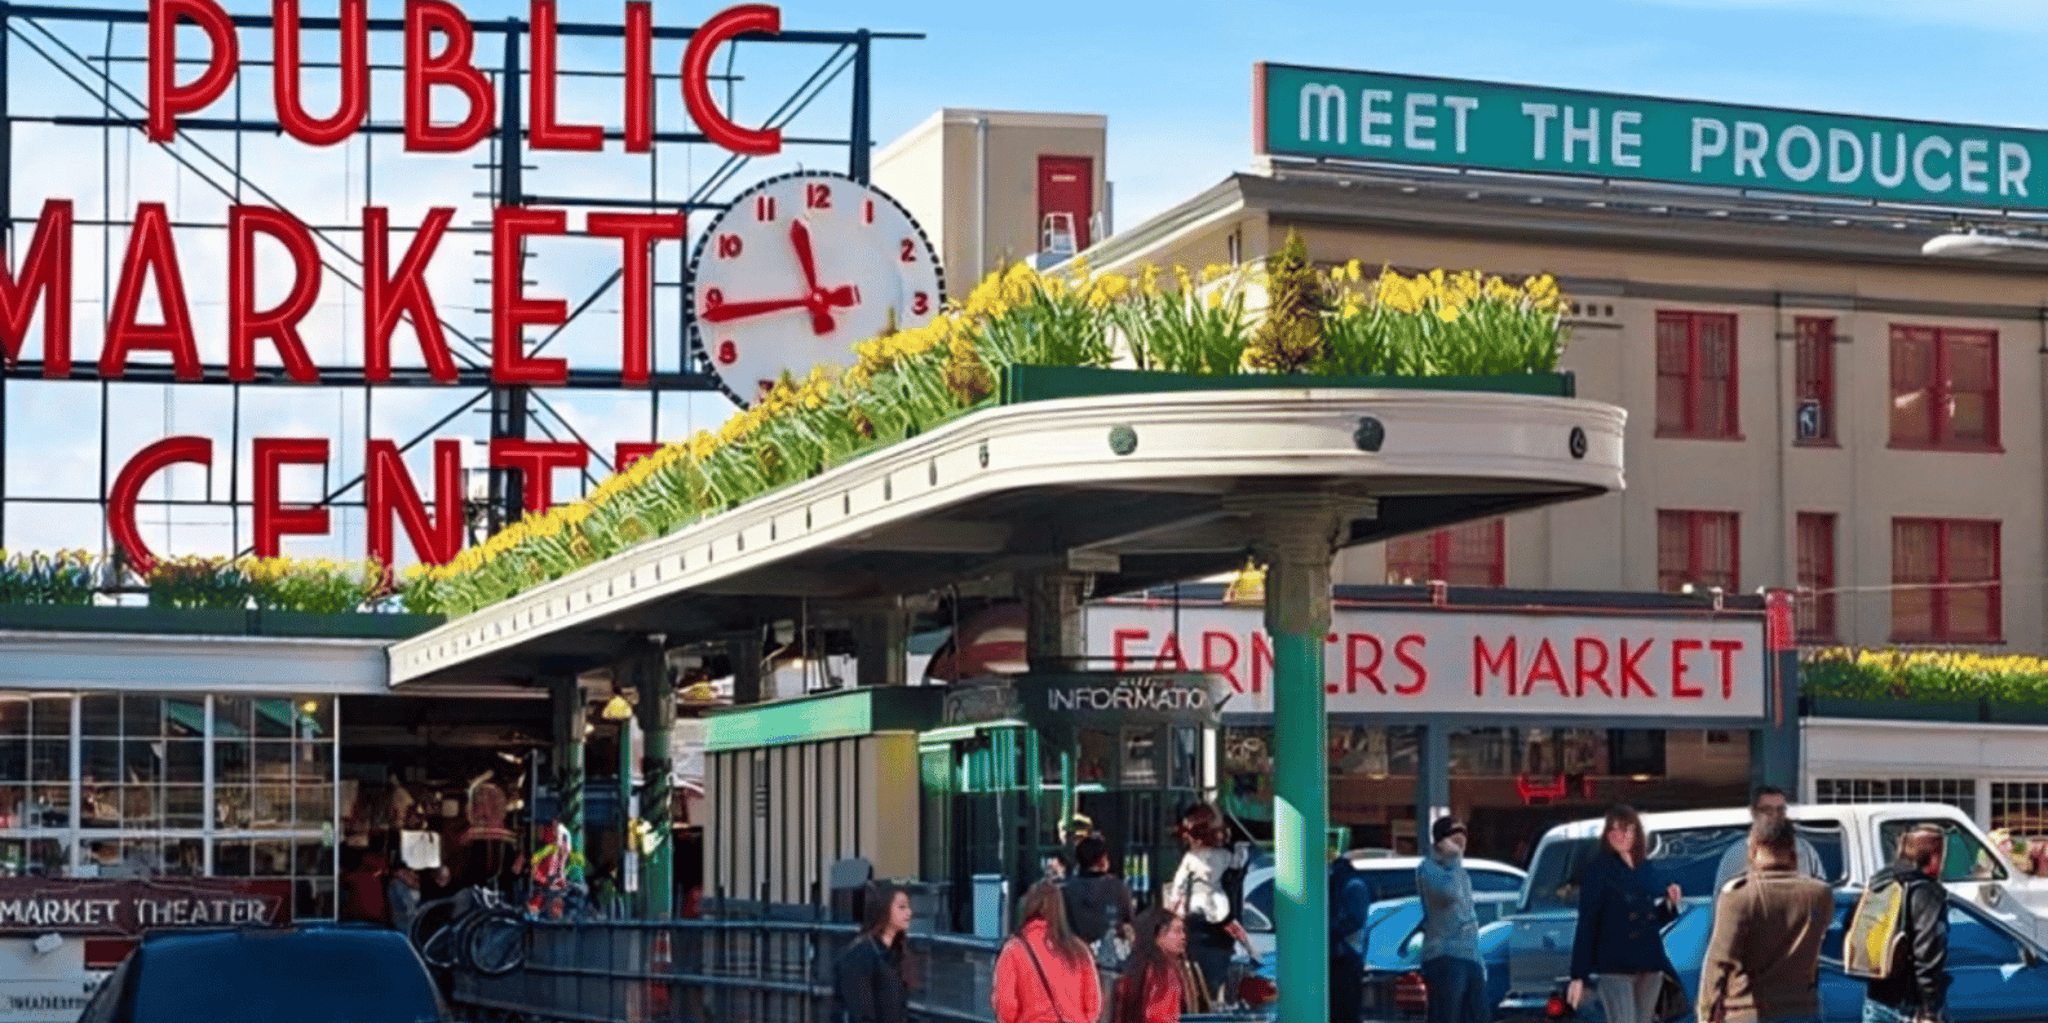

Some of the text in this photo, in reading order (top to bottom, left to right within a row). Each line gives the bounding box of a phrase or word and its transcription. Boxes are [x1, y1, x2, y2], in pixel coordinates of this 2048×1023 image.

[147, 0, 782, 154] PUBLIC
[1299, 82, 2032, 198] MEET THE PRODUCER
[757, 196, 775, 221] 11
[806, 183, 831, 209] 12
[718, 233, 743, 259] 10
[900, 238, 917, 262] 2
[0, 198, 688, 387] MARKET
[911, 291, 929, 316] 3
[718, 340, 738, 365] 8
[107, 435, 666, 594] CENT
[1114, 629, 1744, 700] FARMRS MARKET
[0, 898, 268, 925] MARKET THEATER
